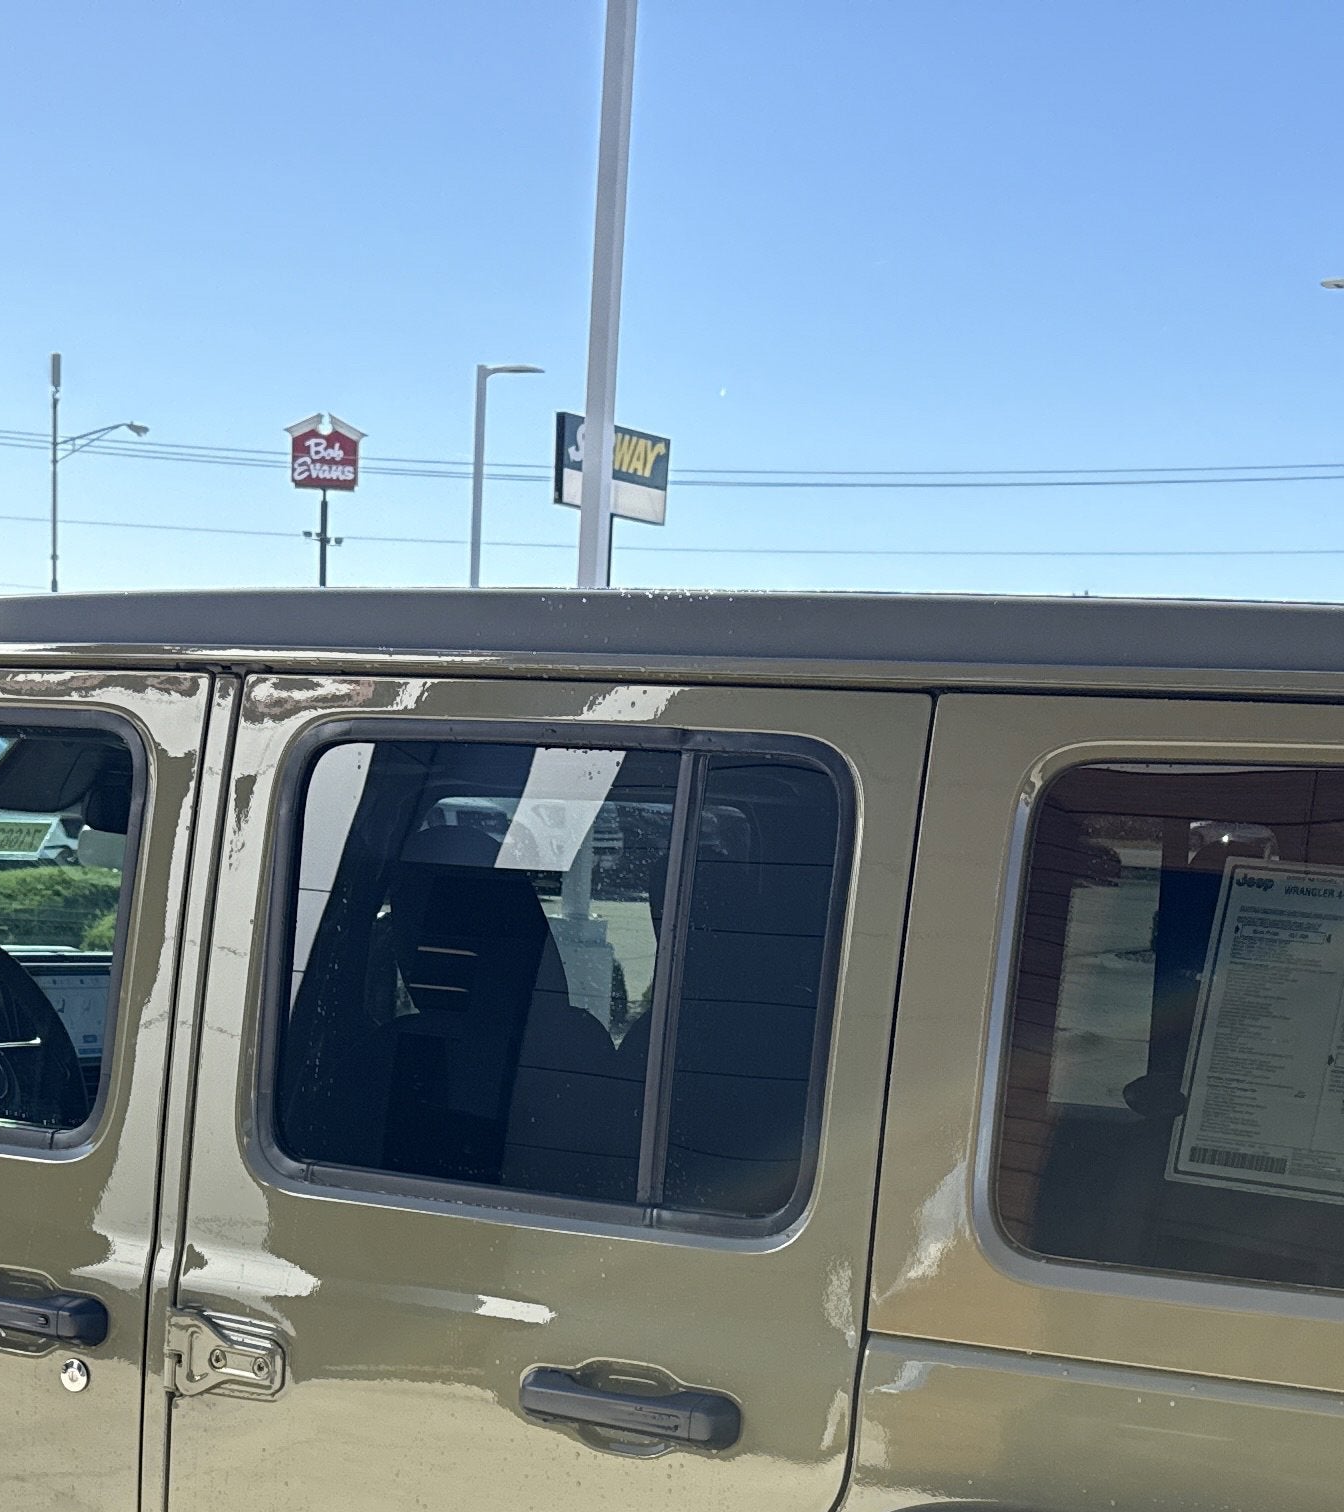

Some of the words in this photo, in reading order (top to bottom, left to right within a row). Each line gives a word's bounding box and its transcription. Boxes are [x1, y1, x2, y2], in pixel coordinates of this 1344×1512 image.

[304, 438, 344, 461] Bob
[568, 423, 666, 478] SWAY
[293, 456, 355, 481] Evans
[1236, 872, 1275, 893] Jeep
[1284, 885, 1335, 899] WRANGLER
